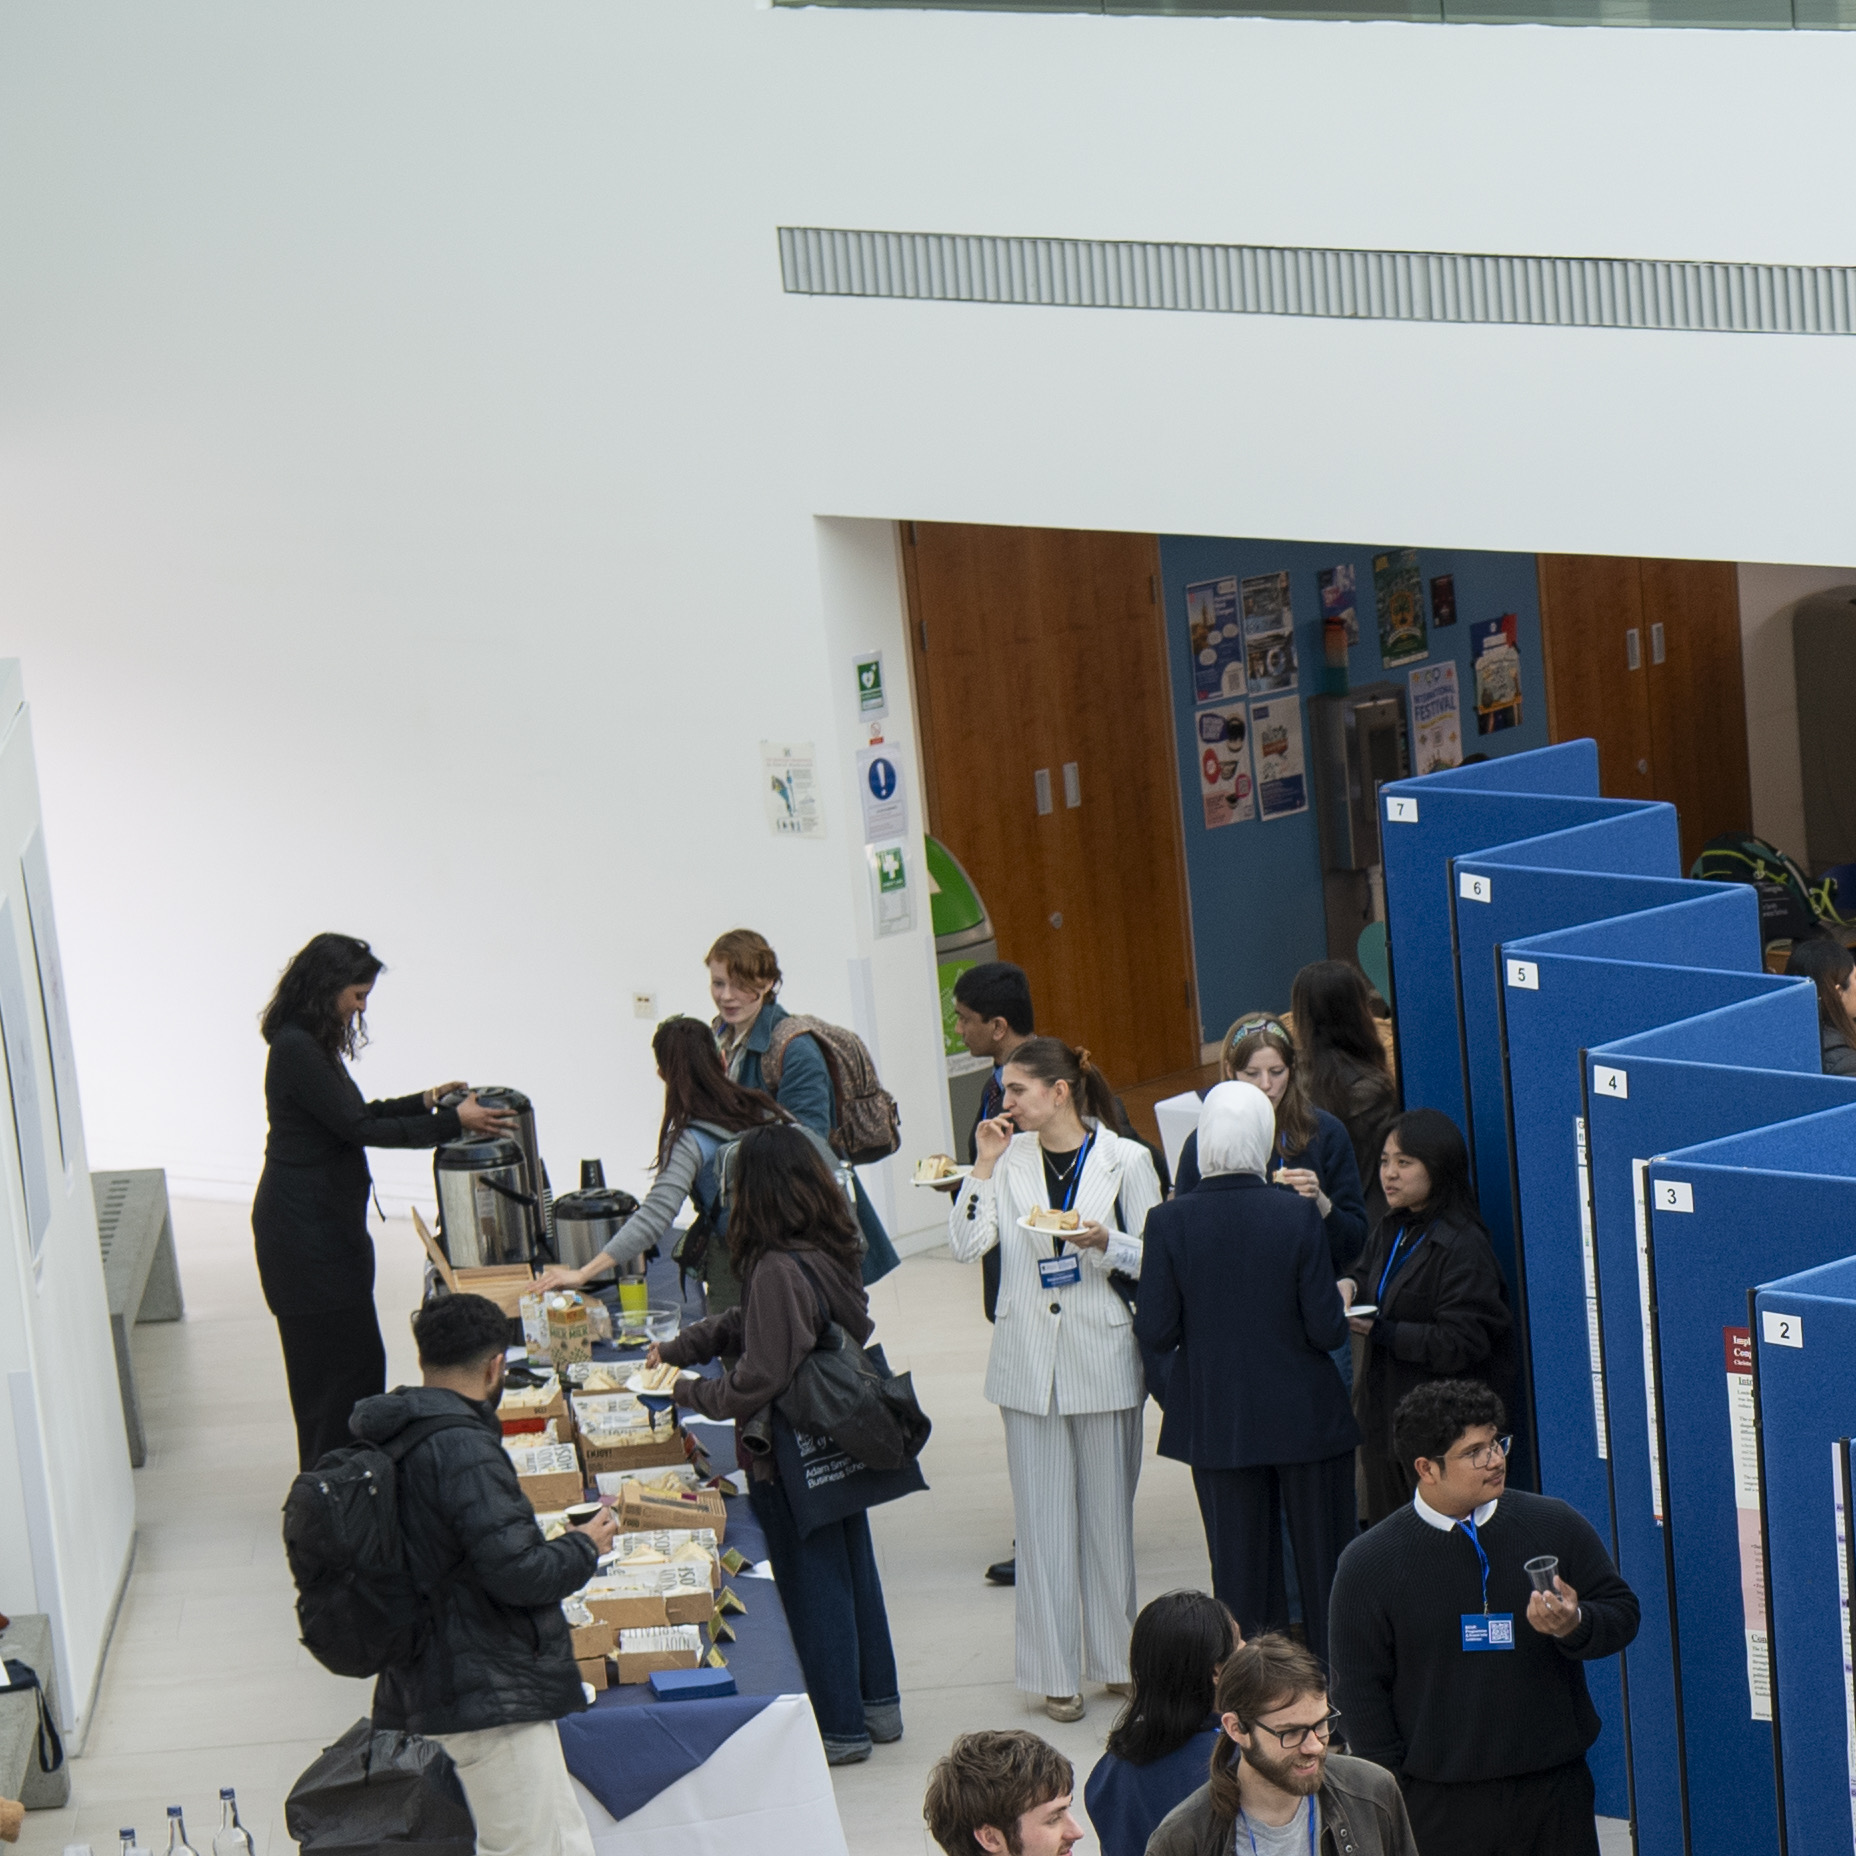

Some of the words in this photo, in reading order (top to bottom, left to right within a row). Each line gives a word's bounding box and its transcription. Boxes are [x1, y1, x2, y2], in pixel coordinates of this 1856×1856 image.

[1414, 694, 1456, 721] FESTIVAL
[1397, 803, 1404, 816] 7
[1473, 882, 1482, 895] 6
[1517, 968, 1525, 981] 5
[1608, 1076, 1617, 1090] 4
[1667, 1188, 1677, 1205] 3
[1779, 1322, 1790, 1339] 2
